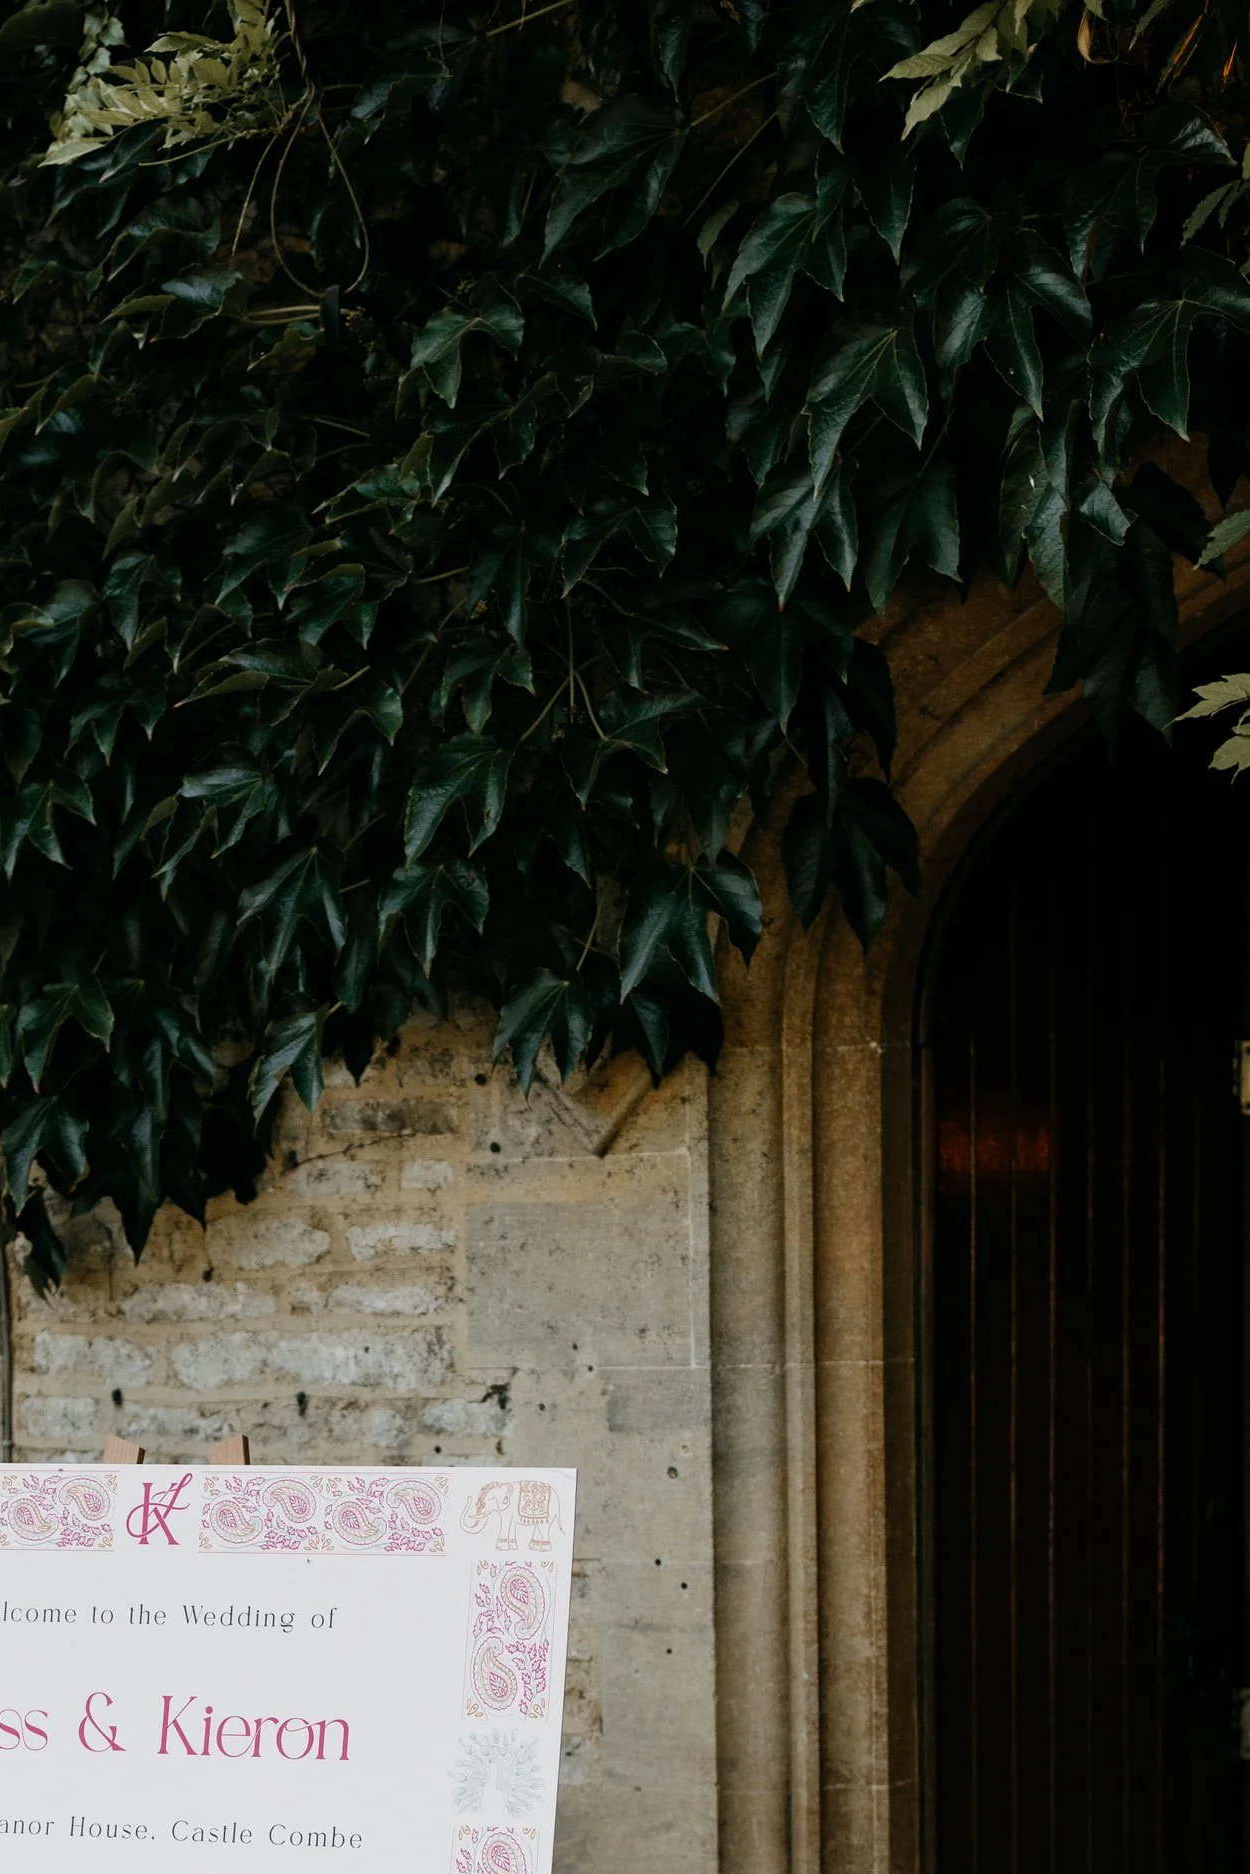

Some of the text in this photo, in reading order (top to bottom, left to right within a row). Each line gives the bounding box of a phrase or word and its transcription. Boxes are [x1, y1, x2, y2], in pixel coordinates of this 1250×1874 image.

[92, 1605, 115, 1625] to
[129, 1603, 168, 1627] the
[182, 1604, 297, 1635] Wedding
[311, 1607, 339, 1630] of
[78, 1691, 127, 1753] &
[157, 1695, 351, 1762] Kieron
[171, 1819, 254, 1846] Castle
[268, 1823, 364, 1850] Combe
